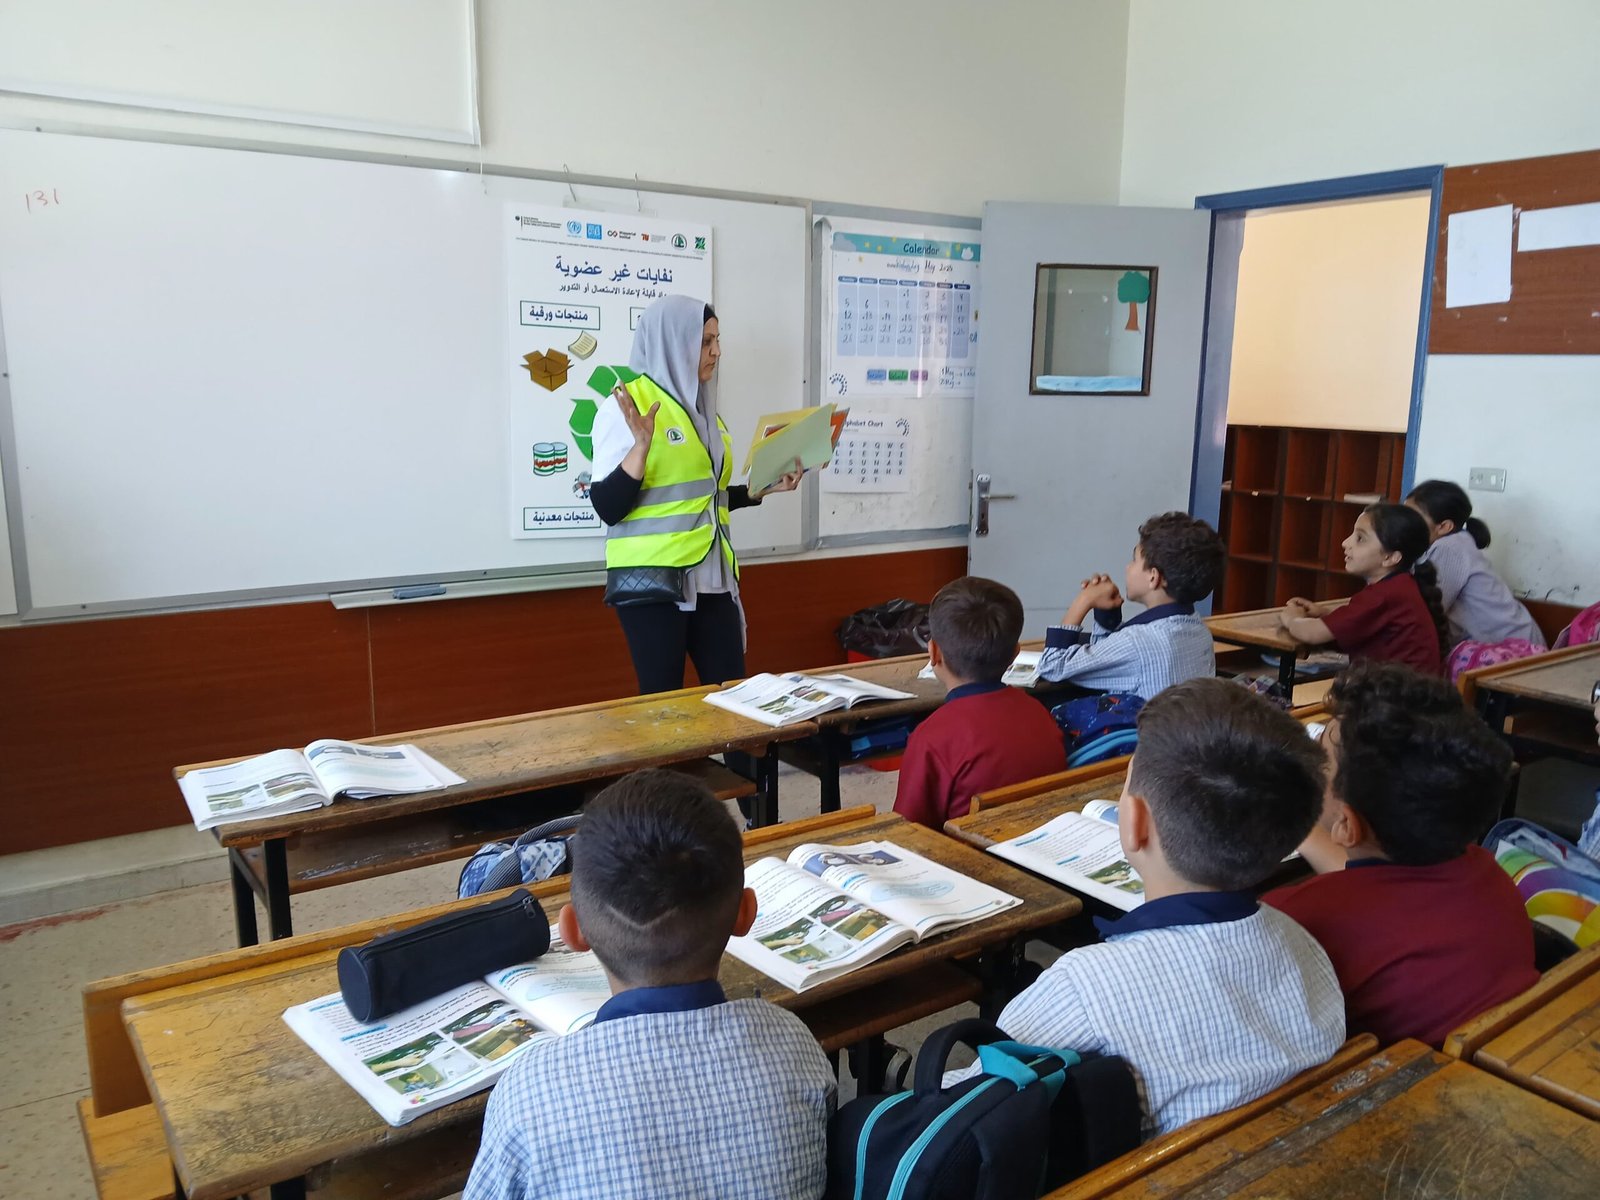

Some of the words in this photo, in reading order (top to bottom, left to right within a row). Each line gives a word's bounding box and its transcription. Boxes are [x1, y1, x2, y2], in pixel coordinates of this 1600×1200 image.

[25, 187, 60, 214] 131
[903, 243, 940, 255] Calendar
[555, 256, 602, 277] عضوية
[609, 263, 631, 282] غير
[637, 267, 672, 285] نفايات
[559, 282, 581, 292] التدوير
[591, 284, 621, 295] الاستعمال
[529, 305, 553, 321] ورقية
[554, 309, 588, 322] منتجات
[844, 419, 866, 428] lphabet
[867, 420, 884, 429] Chart
[533, 511, 562, 525] معدنية
[563, 511, 594, 524] منتجات
